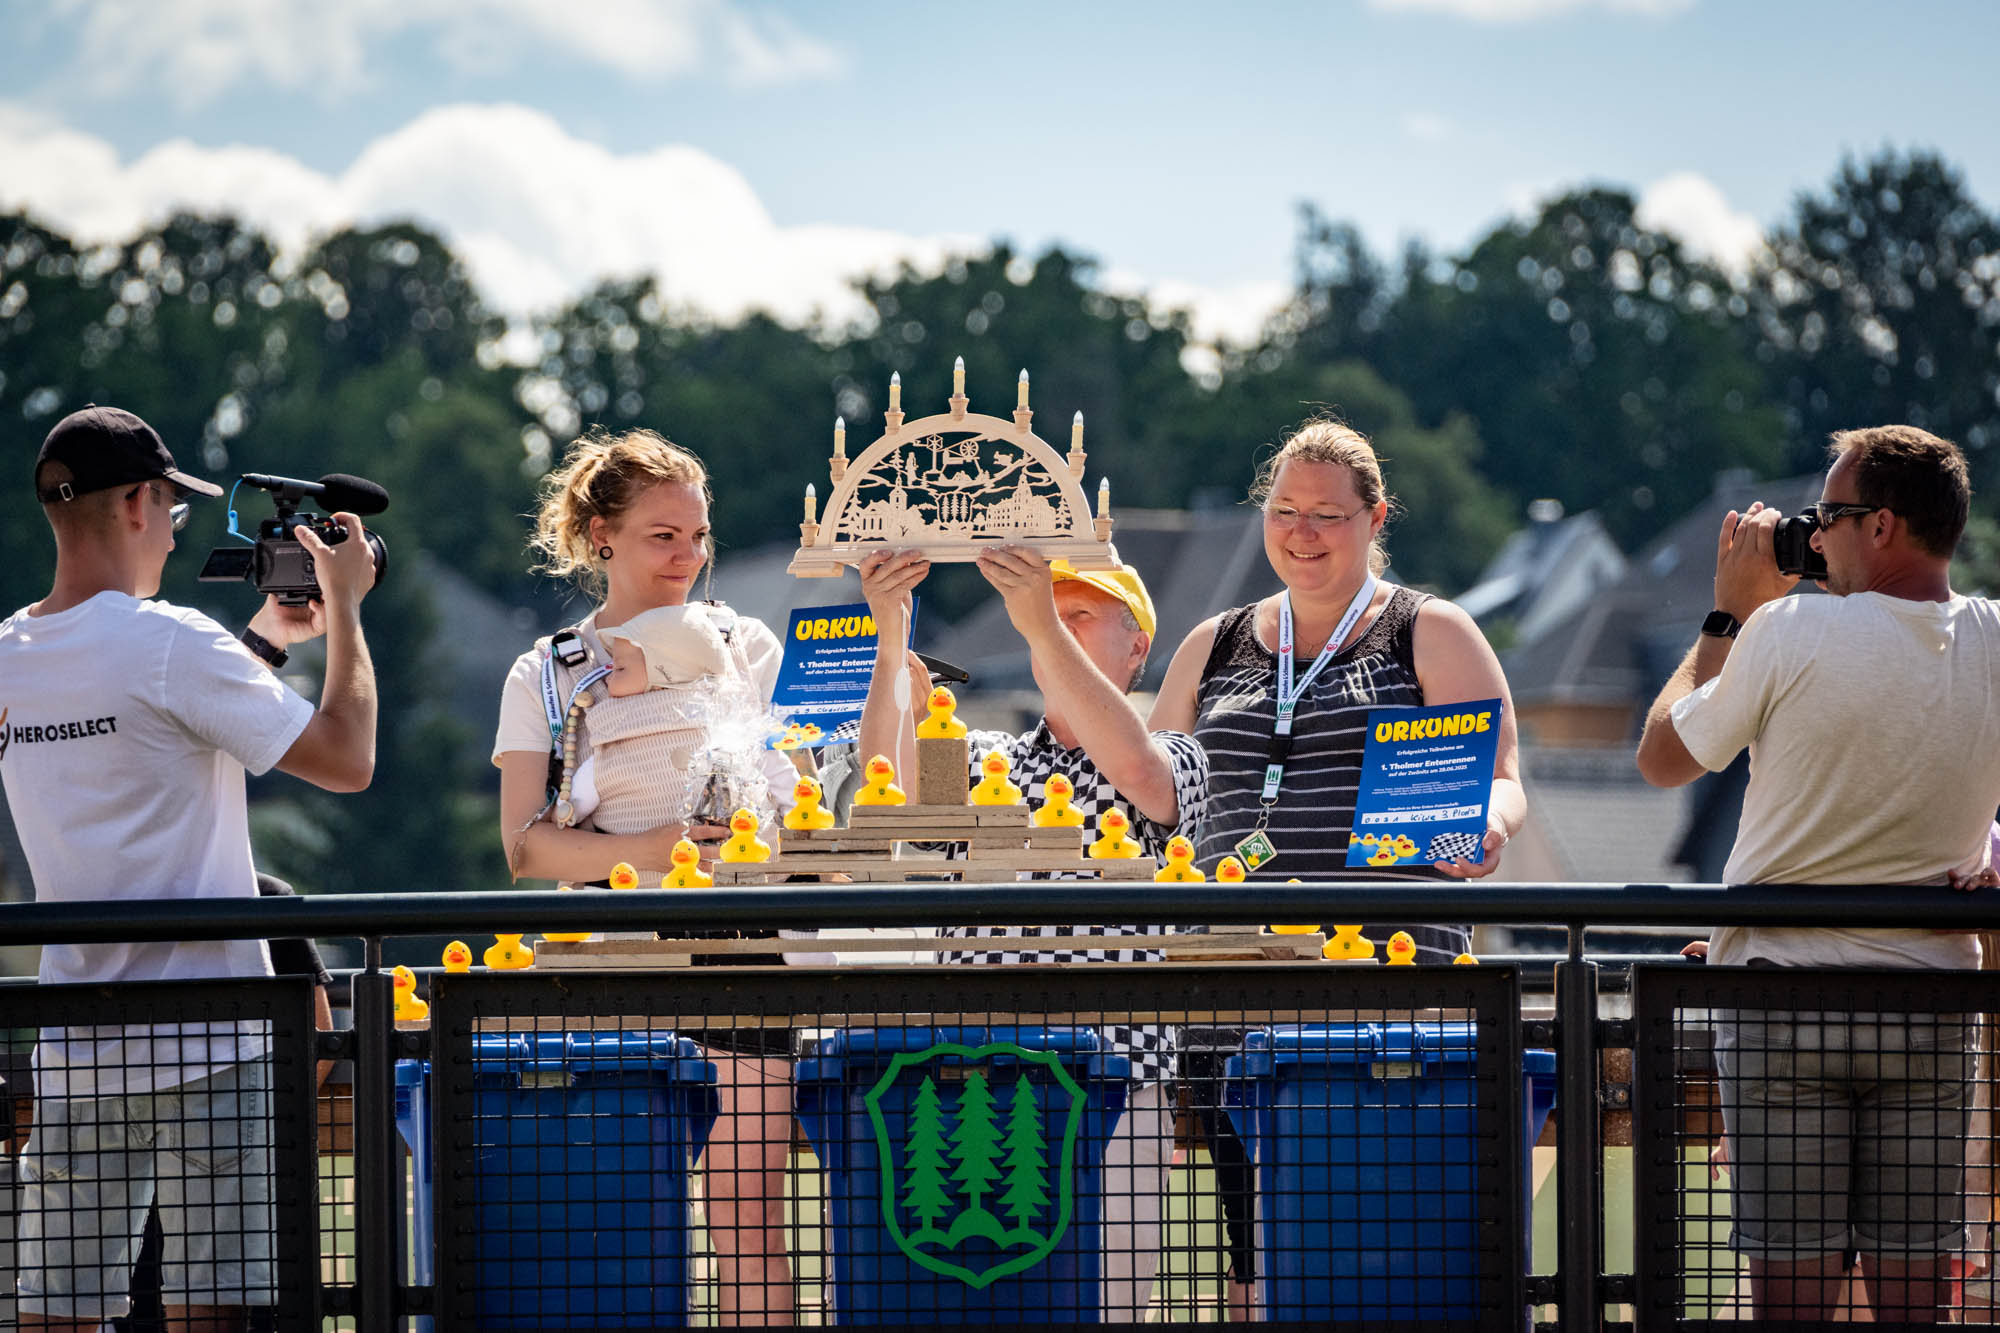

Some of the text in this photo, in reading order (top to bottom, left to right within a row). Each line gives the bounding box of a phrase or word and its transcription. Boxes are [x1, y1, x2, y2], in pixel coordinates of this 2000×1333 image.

[807, 661, 841, 669] Tholmer
[14, 716, 117, 744] HEROSELECT
[1375, 711, 1492, 743] URKUNDE
[1396, 748, 1428, 757] Erfolgreiche
[1429, 745, 1455, 753] Teilnahme
[1389, 761, 1424, 771] Tholmer
[1425, 755, 1477, 768] Entenrennen
[1408, 768, 1429, 776] Zwönitz
